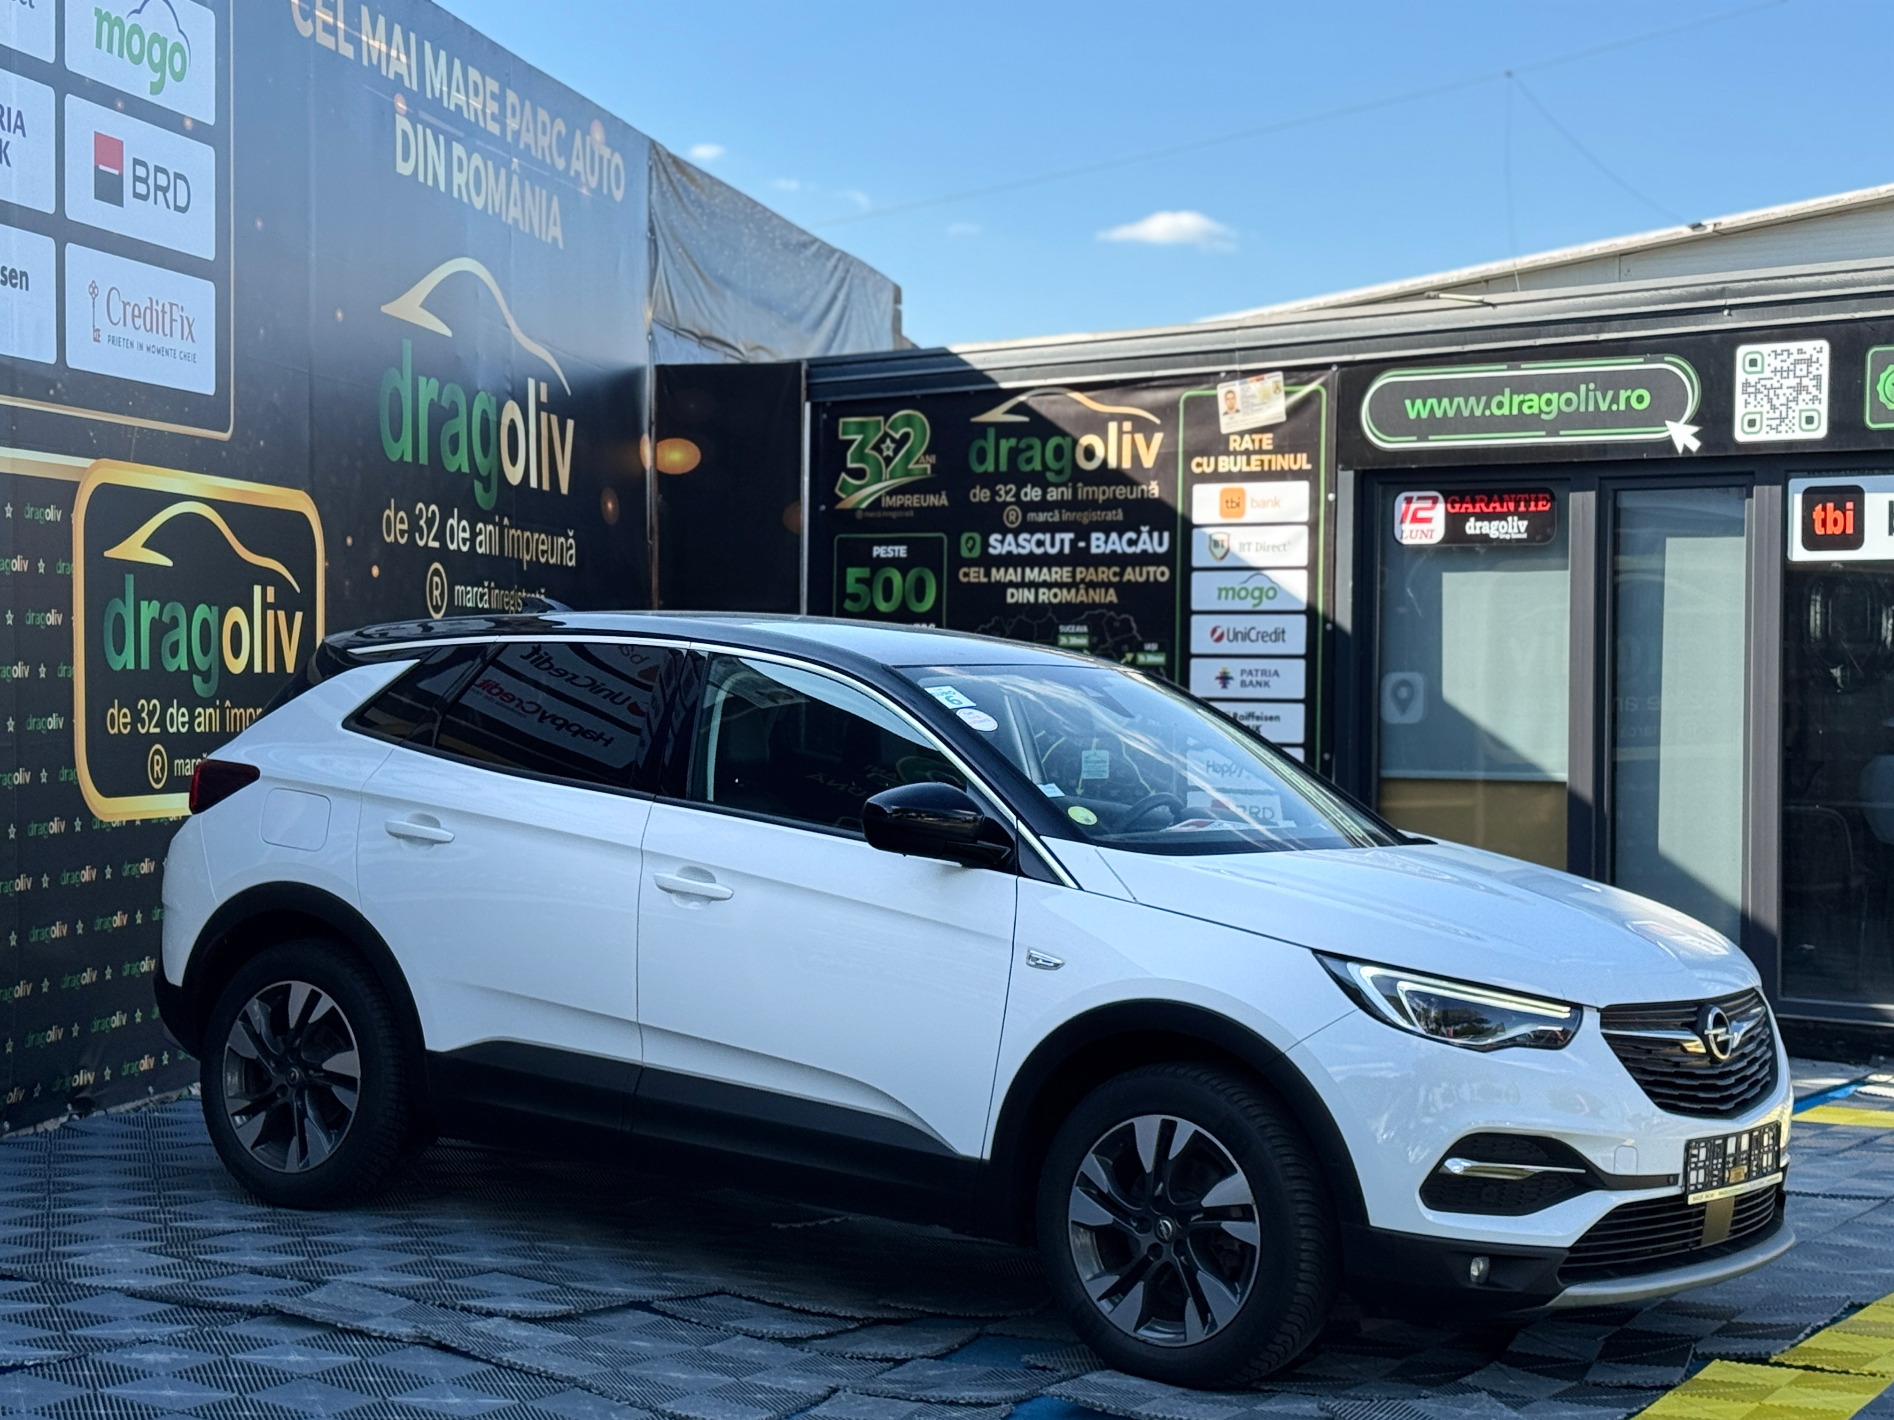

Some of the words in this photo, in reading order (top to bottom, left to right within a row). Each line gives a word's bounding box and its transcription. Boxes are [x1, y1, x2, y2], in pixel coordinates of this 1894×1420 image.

[94, 7, 187, 95] mogo
[289, 0, 354, 60] CEL
[360, 4, 418, 92] MAI
[424, 40, 500, 137] MARE
[505, 88, 566, 171] PARC
[570, 129, 625, 202] AUTO
[132, 157, 191, 214] BRD
[396, 113, 445, 193] DIN
[452, 158, 563, 249] ROMÂNIA
[106, 286, 195, 343] CreditFix
[107, 334, 134, 349] PRIETEN
[136, 342, 144, 351] IN
[146, 344, 177, 359] MOMENTE
[179, 350, 197, 364] CHEIE
[1404, 383, 1651, 421] www.dragoliv.ro
[379, 339, 574, 510] dragoliv
[834, 409, 930, 498] 32
[968, 422, 1164, 483] dragoliv
[1229, 434, 1274, 451] RATE
[1191, 458, 1215, 473] CU
[1217, 453, 1312, 472] BULETINUL
[882, 491, 948, 508] ÎMPREUNĂ
[970, 486, 990, 502] de
[995, 484, 1016, 501] 32
[1020, 483, 1042, 501] de
[1046, 482, 1072, 501] ani
[1077, 480, 1159, 504] împreună
[1225, 496, 1241, 510] tbi
[1251, 496, 1281, 510] bank
[1446, 493, 1552, 513] GARANTIE
[24, 503, 62, 524] dragoliv
[1027, 508, 1060, 522] marcă
[1062, 508, 1123, 524] înregistrată
[1400, 496, 1440, 524] 12
[1812, 501, 1854, 535] tbi
[382, 498, 408, 544] de
[415, 502, 440, 548] 32
[446, 508, 471, 553] de
[476, 516, 500, 556] ani
[504, 516, 576, 571] împreună
[1400, 529, 1434, 540] LUNI
[1464, 516, 1529, 539] dragoliv
[872, 545, 908, 558] PESTE
[988, 532, 1075, 555] SASCUT
[1090, 526, 1170, 554] BACĂU
[1238, 540, 1252, 553] BT
[958, 566, 989, 583] CEL
[991, 566, 1022, 583] MAI
[1024, 566, 1073, 583] MARE
[1076, 566, 1120, 582] PARC
[1122, 565, 1170, 582] AUTO
[454, 580, 490, 608] marcă
[843, 566, 937, 613] 500
[1006, 588, 1037, 605] DIN
[1038, 583, 1118, 605] ROMÂNIA
[1217, 584, 1278, 608] mogo
[26, 609, 63, 630] dragoliv
[104, 574, 303, 698] dragoliv
[1226, 626, 1287, 644] UniCredit
[1240, 668, 1281, 679] PATRIA
[1240, 679, 1271, 689] BANK
[26, 713, 64, 734] dragoliv
[106, 700, 131, 734] de
[137, 699, 161, 734] 32
[166, 700, 189, 734] de
[194, 700, 220, 733] ani
[1232, 711, 1281, 722] Raiffeisen
[28, 818, 66, 839] dragoliv
[60, 865, 97, 888] dragoliv
[122, 858, 155, 879] dragoliv
[29, 921, 67, 944] dragoliv
[94, 911, 128, 934] dragoliv
[61, 967, 97, 990] dragoliv
[122, 956, 155, 978] dragoliv
[90, 1010, 127, 1034] dragoliv
[24, 1025, 64, 1049] dragoliv
[120, 1054, 155, 1077] dragoliv
